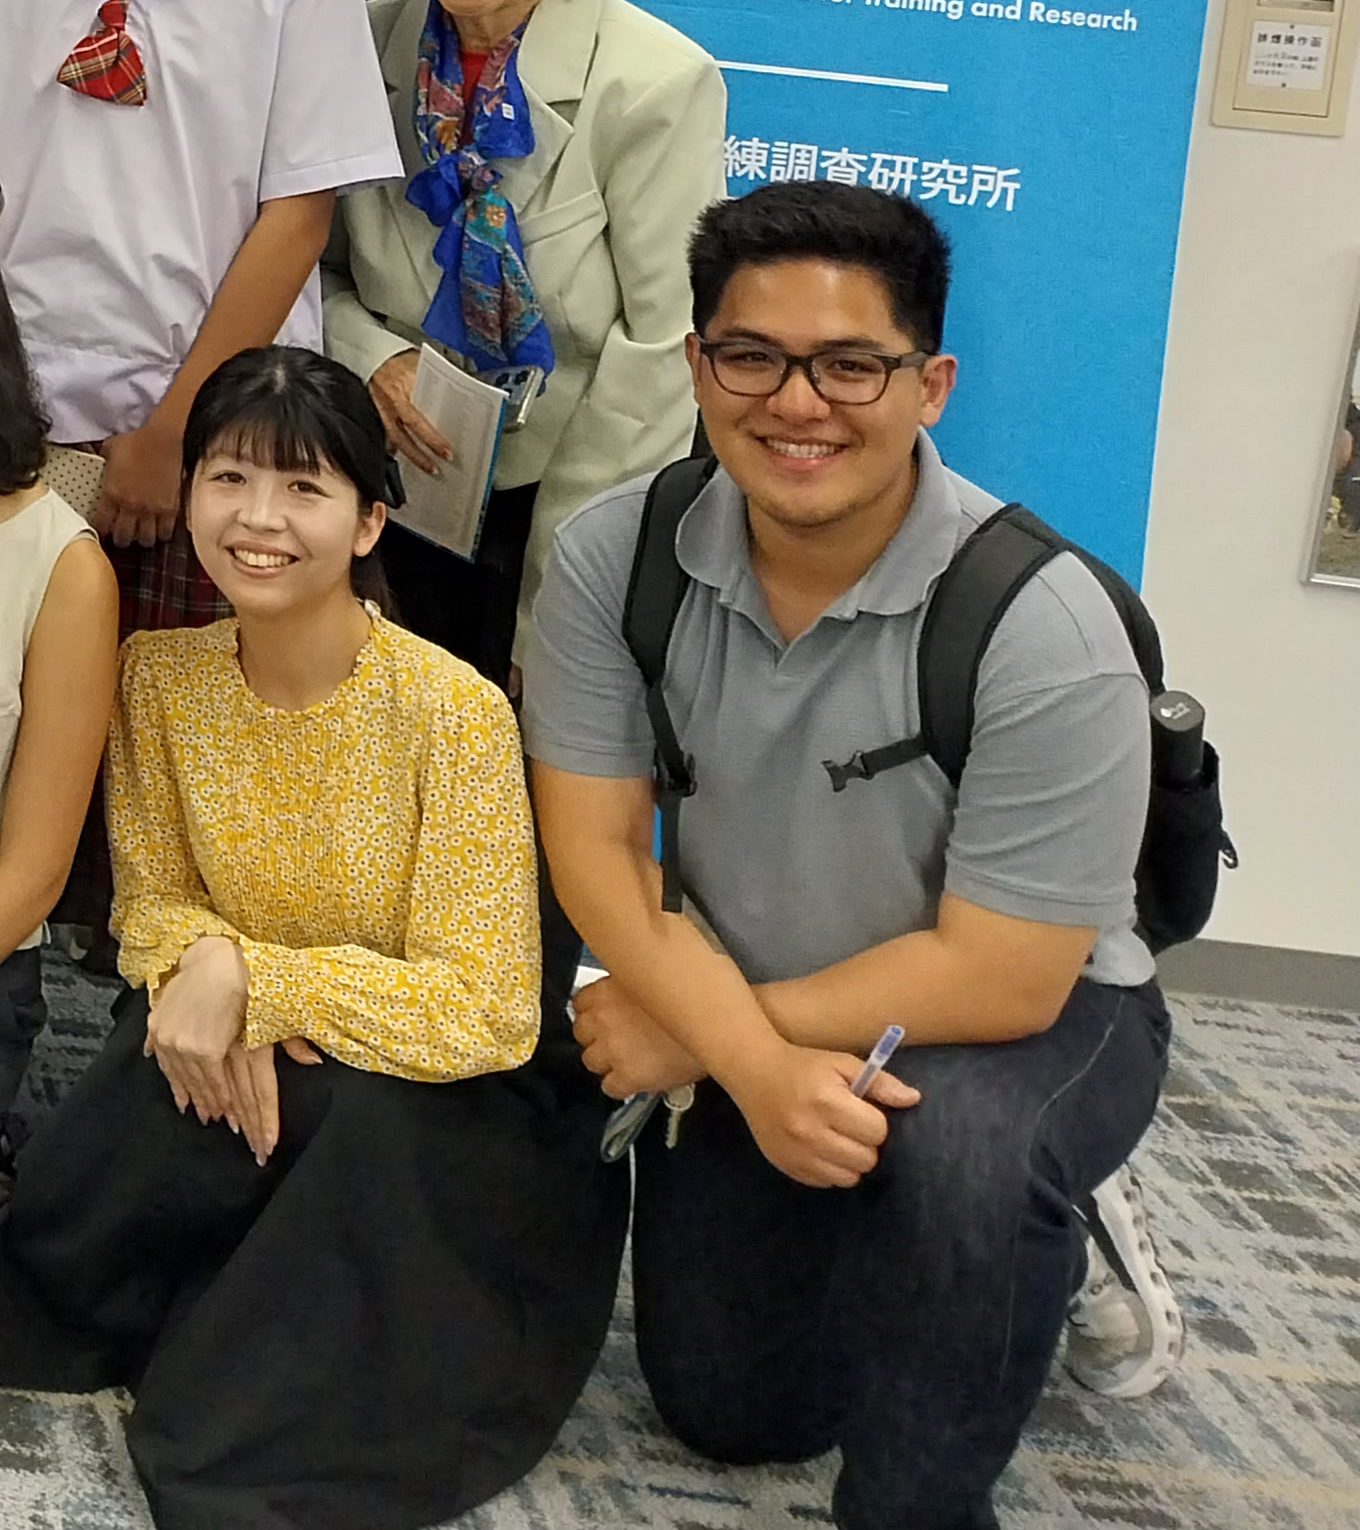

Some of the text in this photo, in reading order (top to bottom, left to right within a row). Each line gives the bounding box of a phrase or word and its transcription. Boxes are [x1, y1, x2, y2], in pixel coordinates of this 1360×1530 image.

[1029, 1, 1138, 32] Research
[723, 134, 1021, 211] 練調査研究所
